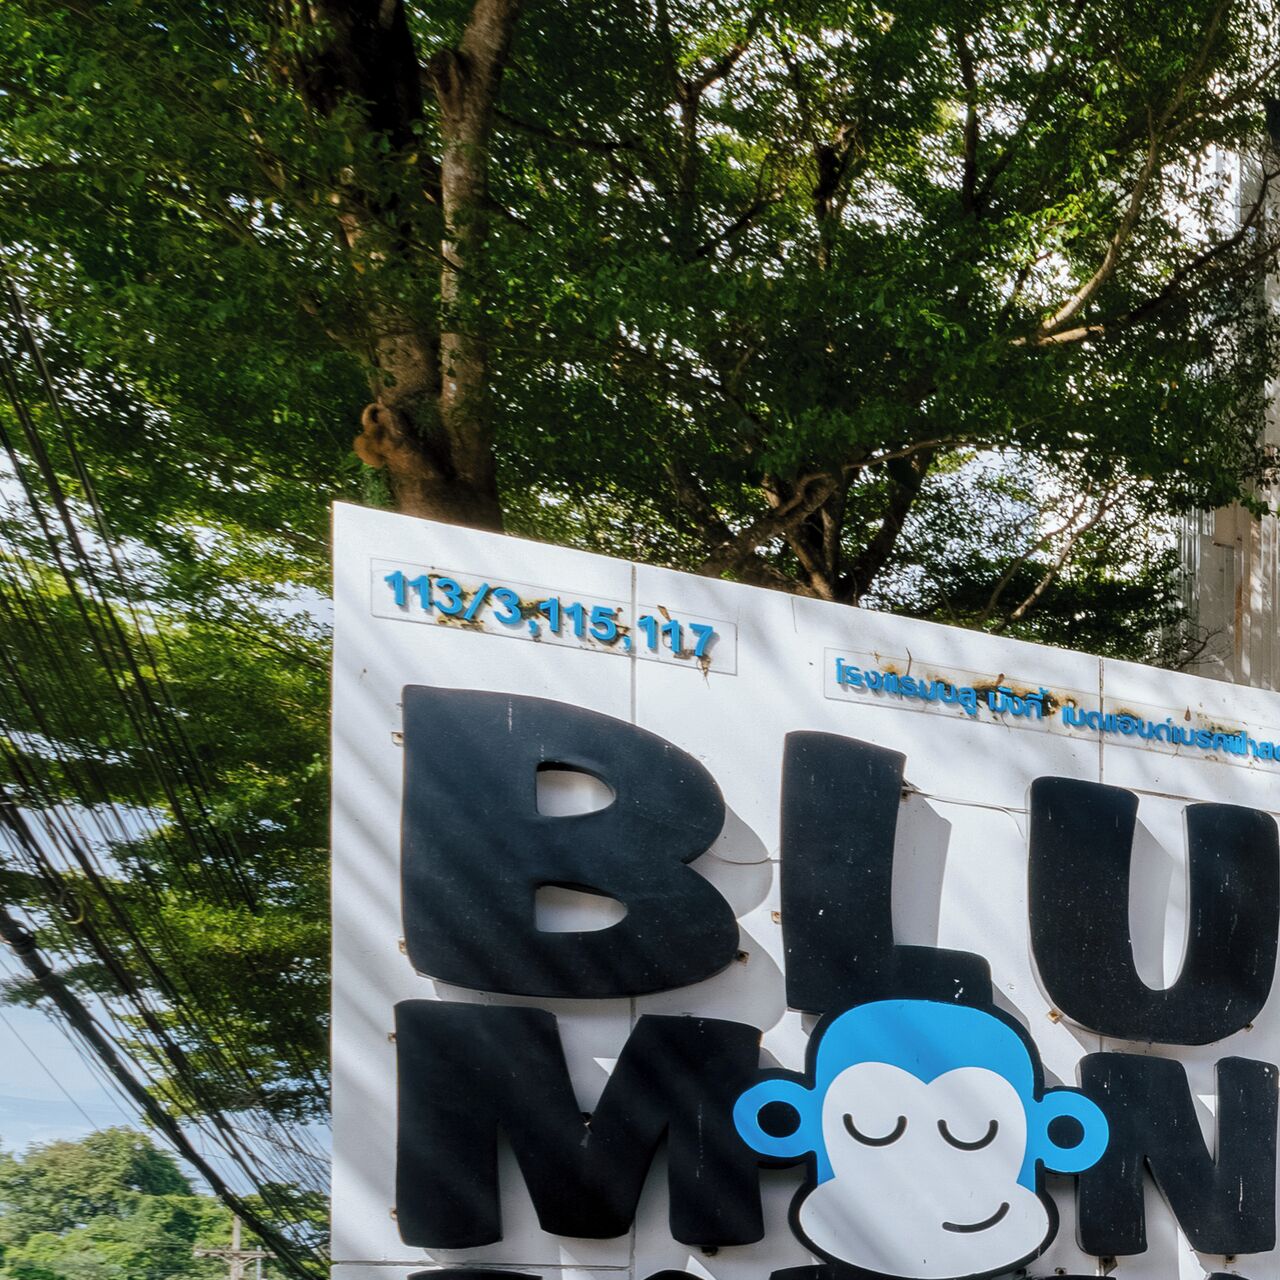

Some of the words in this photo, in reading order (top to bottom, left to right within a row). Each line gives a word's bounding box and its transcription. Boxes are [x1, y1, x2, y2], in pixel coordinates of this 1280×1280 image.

[384, 570, 714, 657] 113/3,115,117
[402, 684, 1280, 1046] BLU
[394, 998, 1280, 1255] MN
